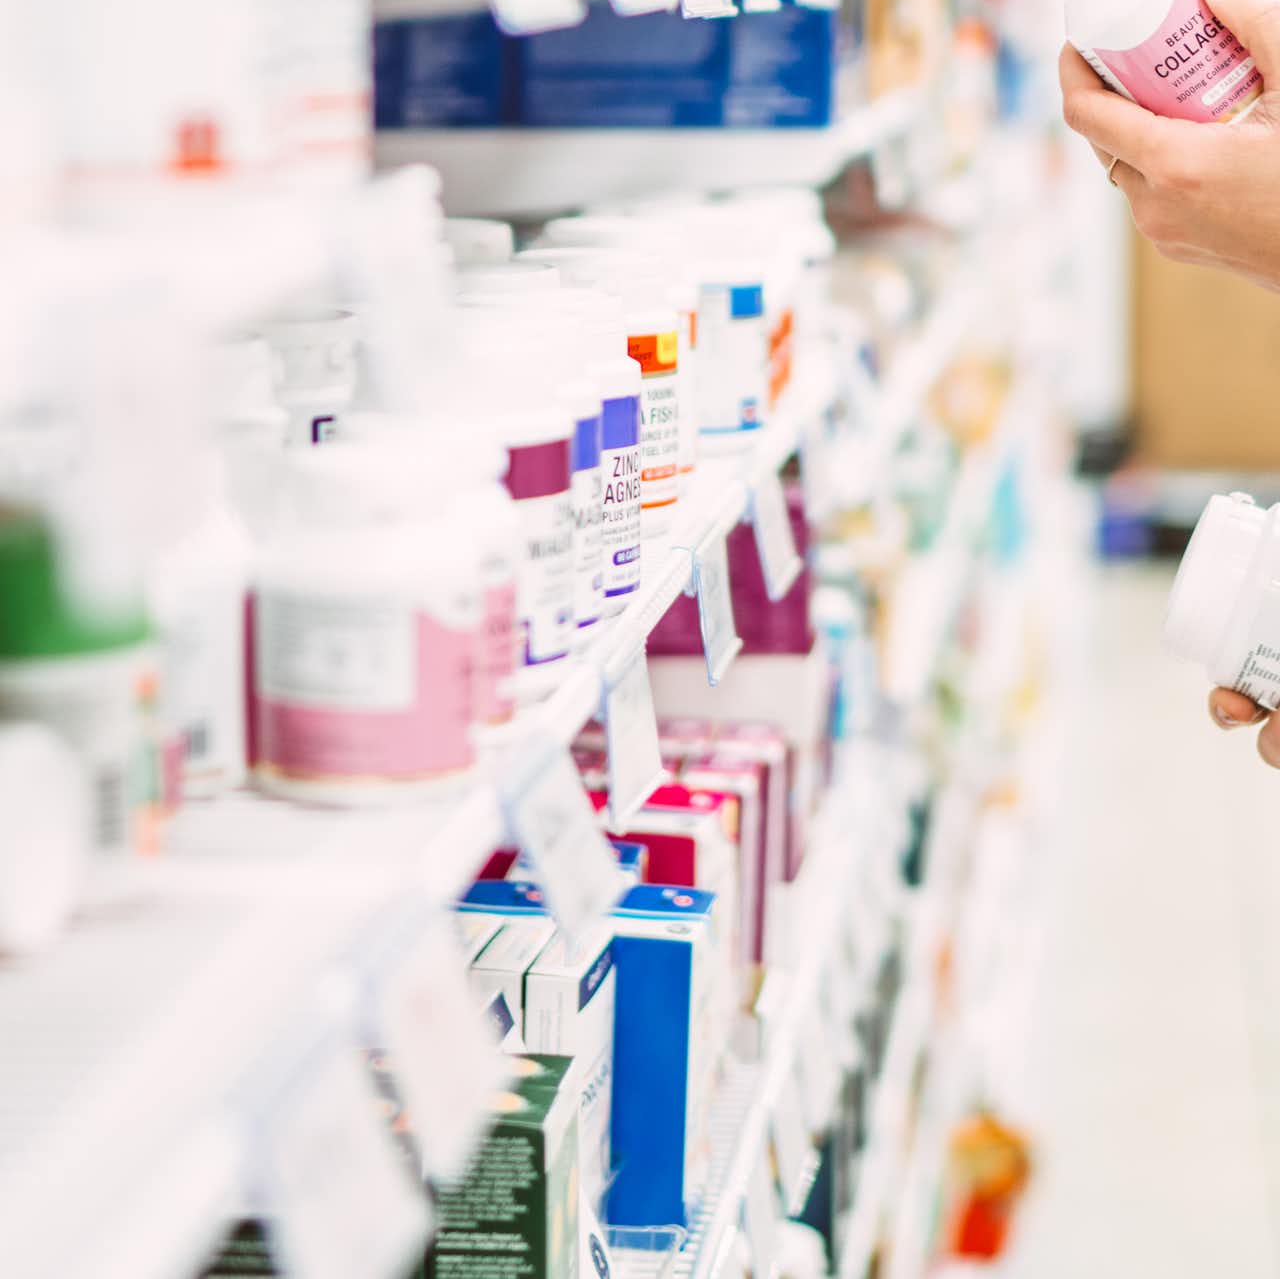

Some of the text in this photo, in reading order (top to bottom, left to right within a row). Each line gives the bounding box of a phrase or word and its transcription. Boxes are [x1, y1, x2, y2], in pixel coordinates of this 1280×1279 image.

[1165, 10, 1205, 48] BEAUTY
[1171, 61, 1204, 89] VITAMIN
[1204, 54, 1213, 63] C
[1212, 48, 1220, 57] &
[1206, 53, 1236, 80] Collagen
[1210, 100, 1230, 116] FOOD
